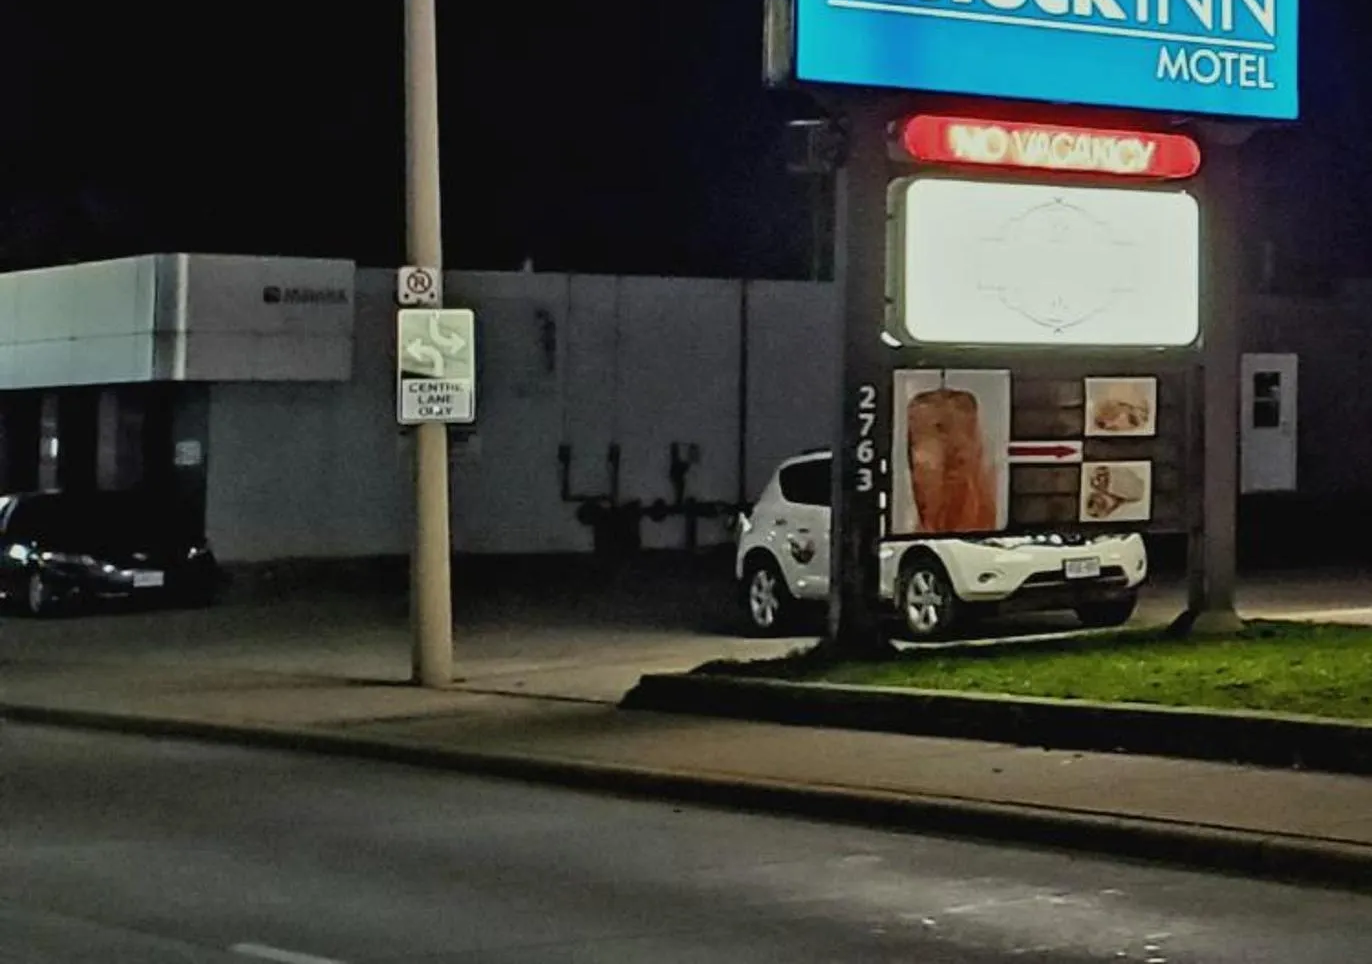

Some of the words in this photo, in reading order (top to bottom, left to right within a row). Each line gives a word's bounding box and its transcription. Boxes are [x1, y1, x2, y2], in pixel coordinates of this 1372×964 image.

[1156, 47, 1274, 90] MOTEL
[947, 124, 1008, 163] NO
[1012, 130, 1156, 173] VACANCY
[408, 382, 465, 393] CENTRE
[418, 394, 452, 404] LANE
[857, 386, 876, 491] 2763
